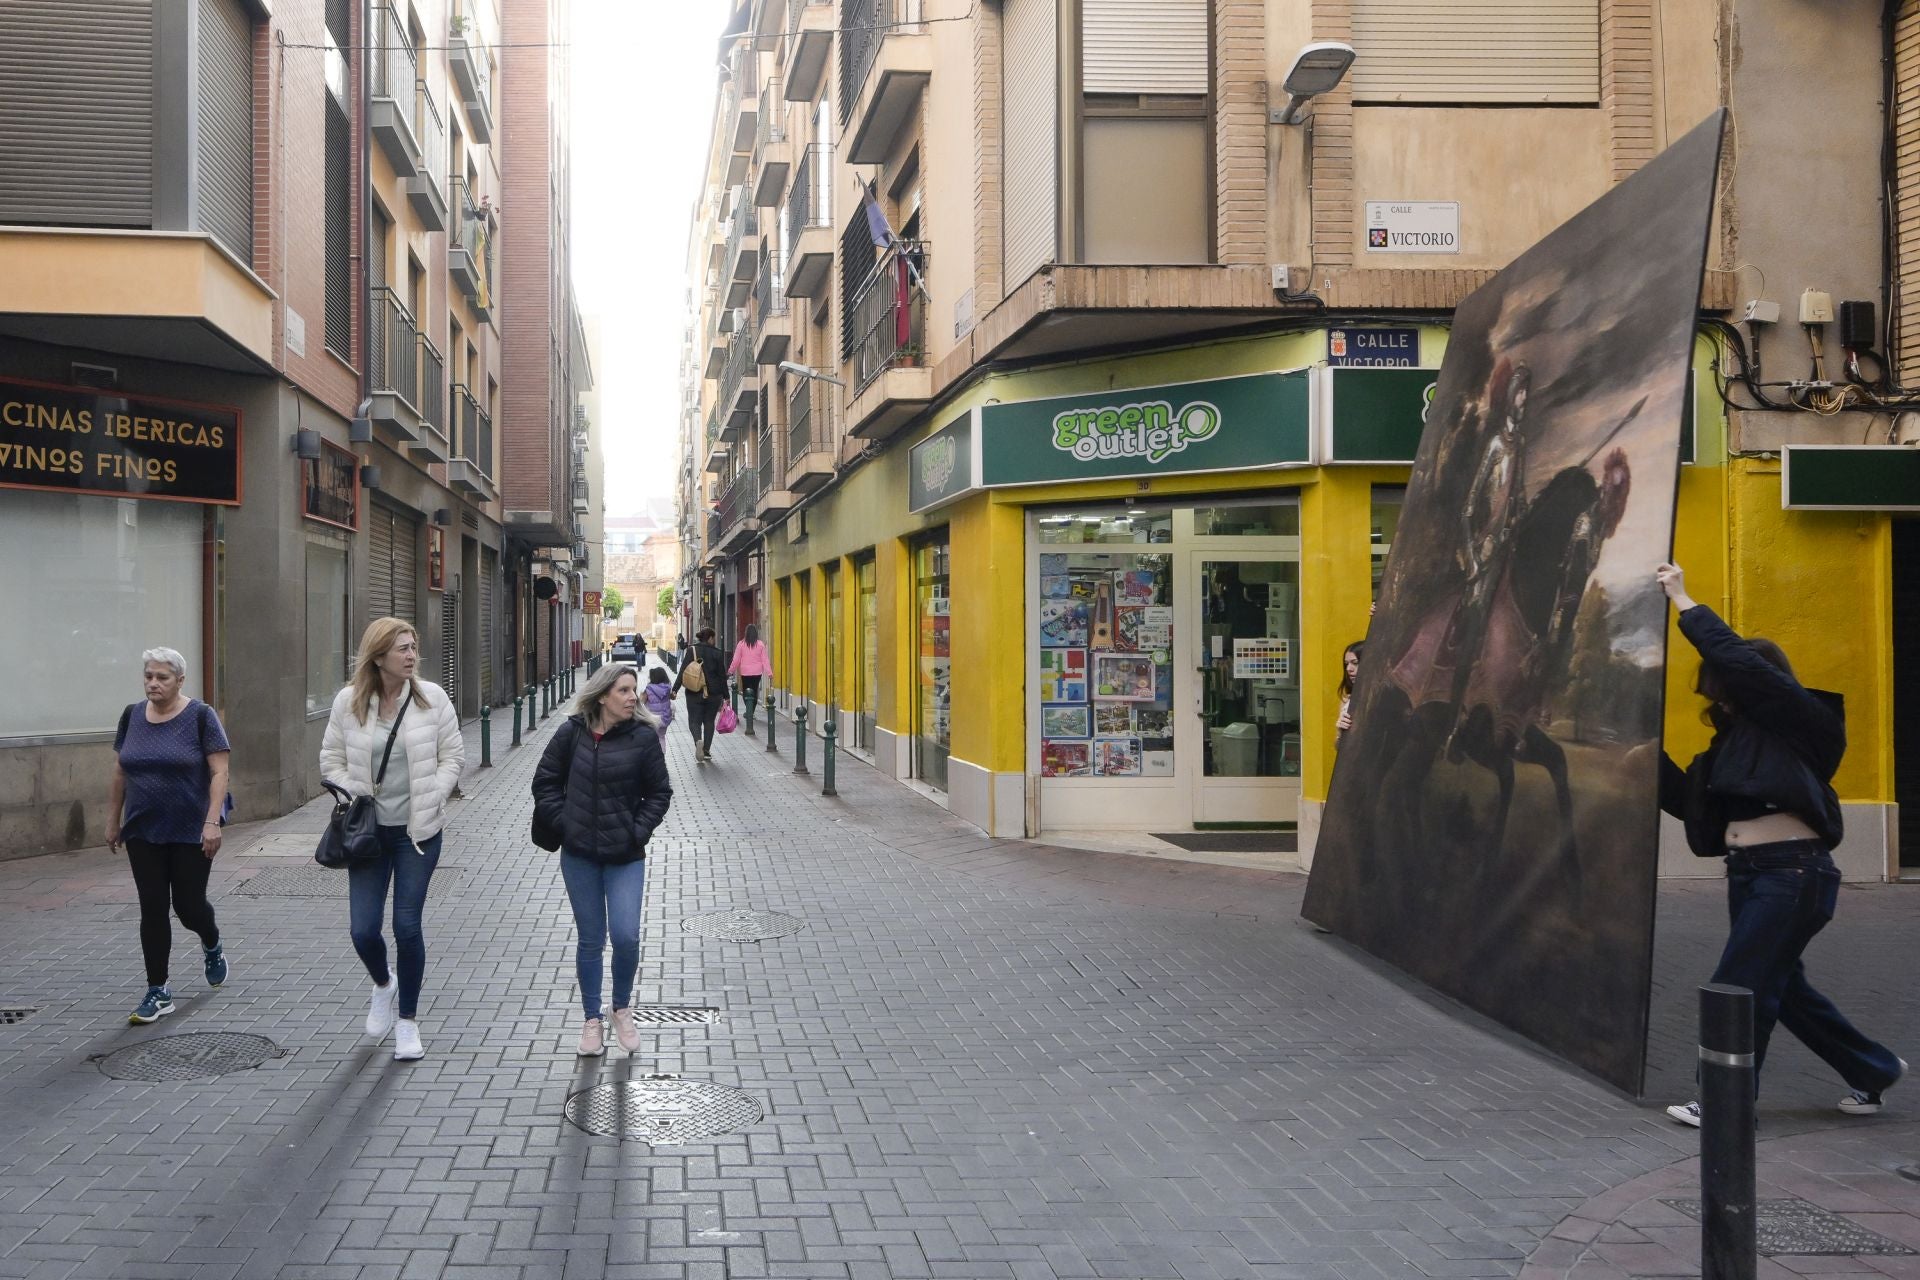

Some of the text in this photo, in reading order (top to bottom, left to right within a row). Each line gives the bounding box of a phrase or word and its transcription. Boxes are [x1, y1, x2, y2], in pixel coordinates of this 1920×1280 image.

[1391, 206, 1412, 214] CALLE
[1391, 232, 1454, 246] VICTORIO
[1357, 334, 1409, 348] CALLE
[0, 401, 224, 448] CINAS IBERICAS
[1056, 403, 1169, 448] green
[1075, 422, 1184, 459] outlet
